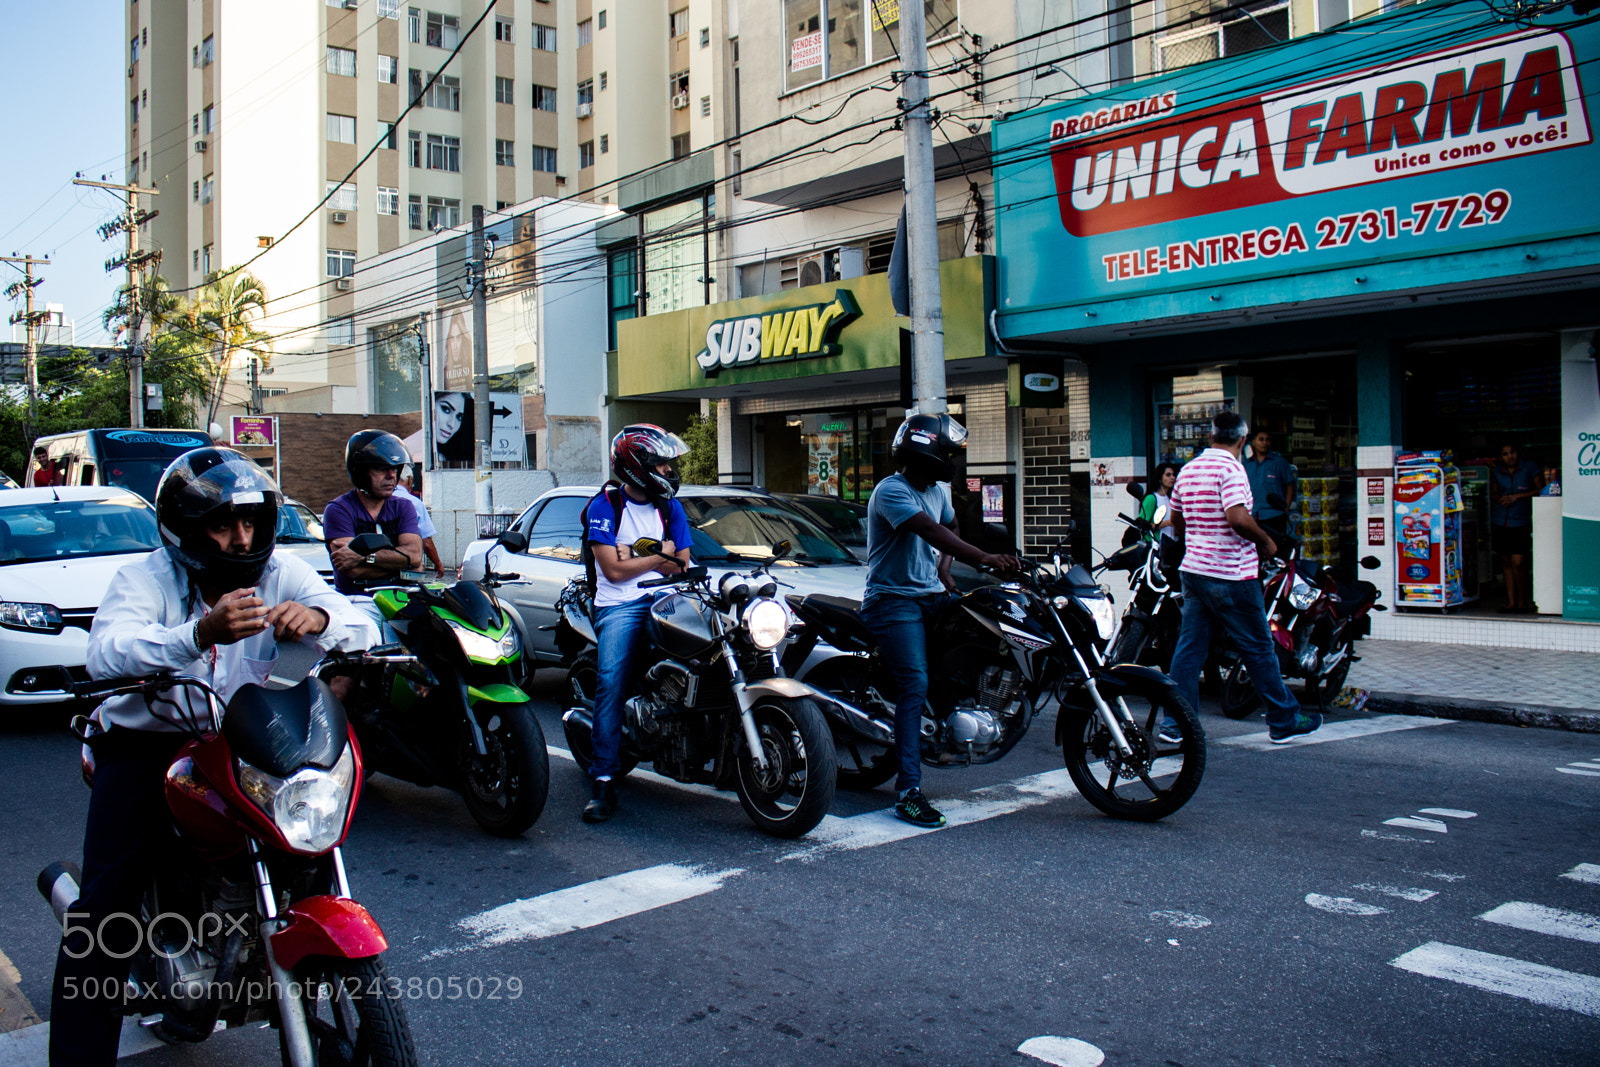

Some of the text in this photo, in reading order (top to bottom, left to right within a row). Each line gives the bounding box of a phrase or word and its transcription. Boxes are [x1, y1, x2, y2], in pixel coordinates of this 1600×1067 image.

[793, 33, 821, 51] VENDE-SE
[1051, 91, 1177, 141] DROGARIAS
[1071, 45, 1568, 211] UNICA FARMA
[1439, 141, 1496, 162] como
[1505, 121, 1568, 149] você!
[1104, 190, 1510, 281] TELE-ENTREGA 2731-7729
[697, 299, 845, 370] SUBWAY
[819, 461, 829, 481] 8
